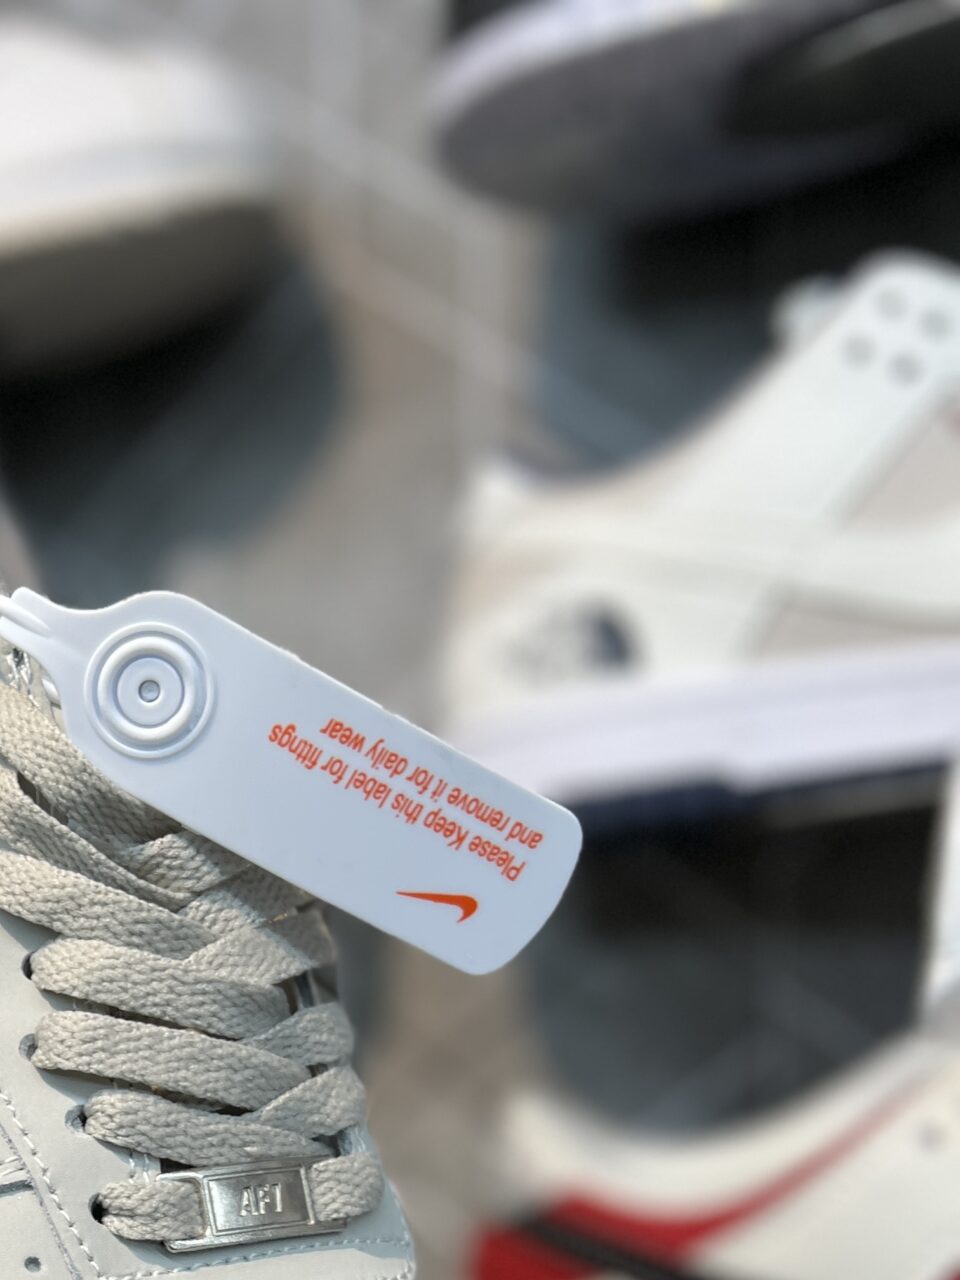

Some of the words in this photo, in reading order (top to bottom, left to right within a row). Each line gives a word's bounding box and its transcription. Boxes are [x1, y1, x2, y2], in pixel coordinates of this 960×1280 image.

[320, 719, 366, 752] wear
[320, 757, 349, 784] for
[365, 739, 409, 777] daily
[345, 771, 392, 807] label
[405, 767, 434, 795] for
[431, 780, 448, 800] it
[392, 793, 425, 824] this
[447, 787, 510, 832] remove
[424, 809, 469, 849] Keep
[506, 821, 544, 849] and
[468, 835, 525, 881] Please
